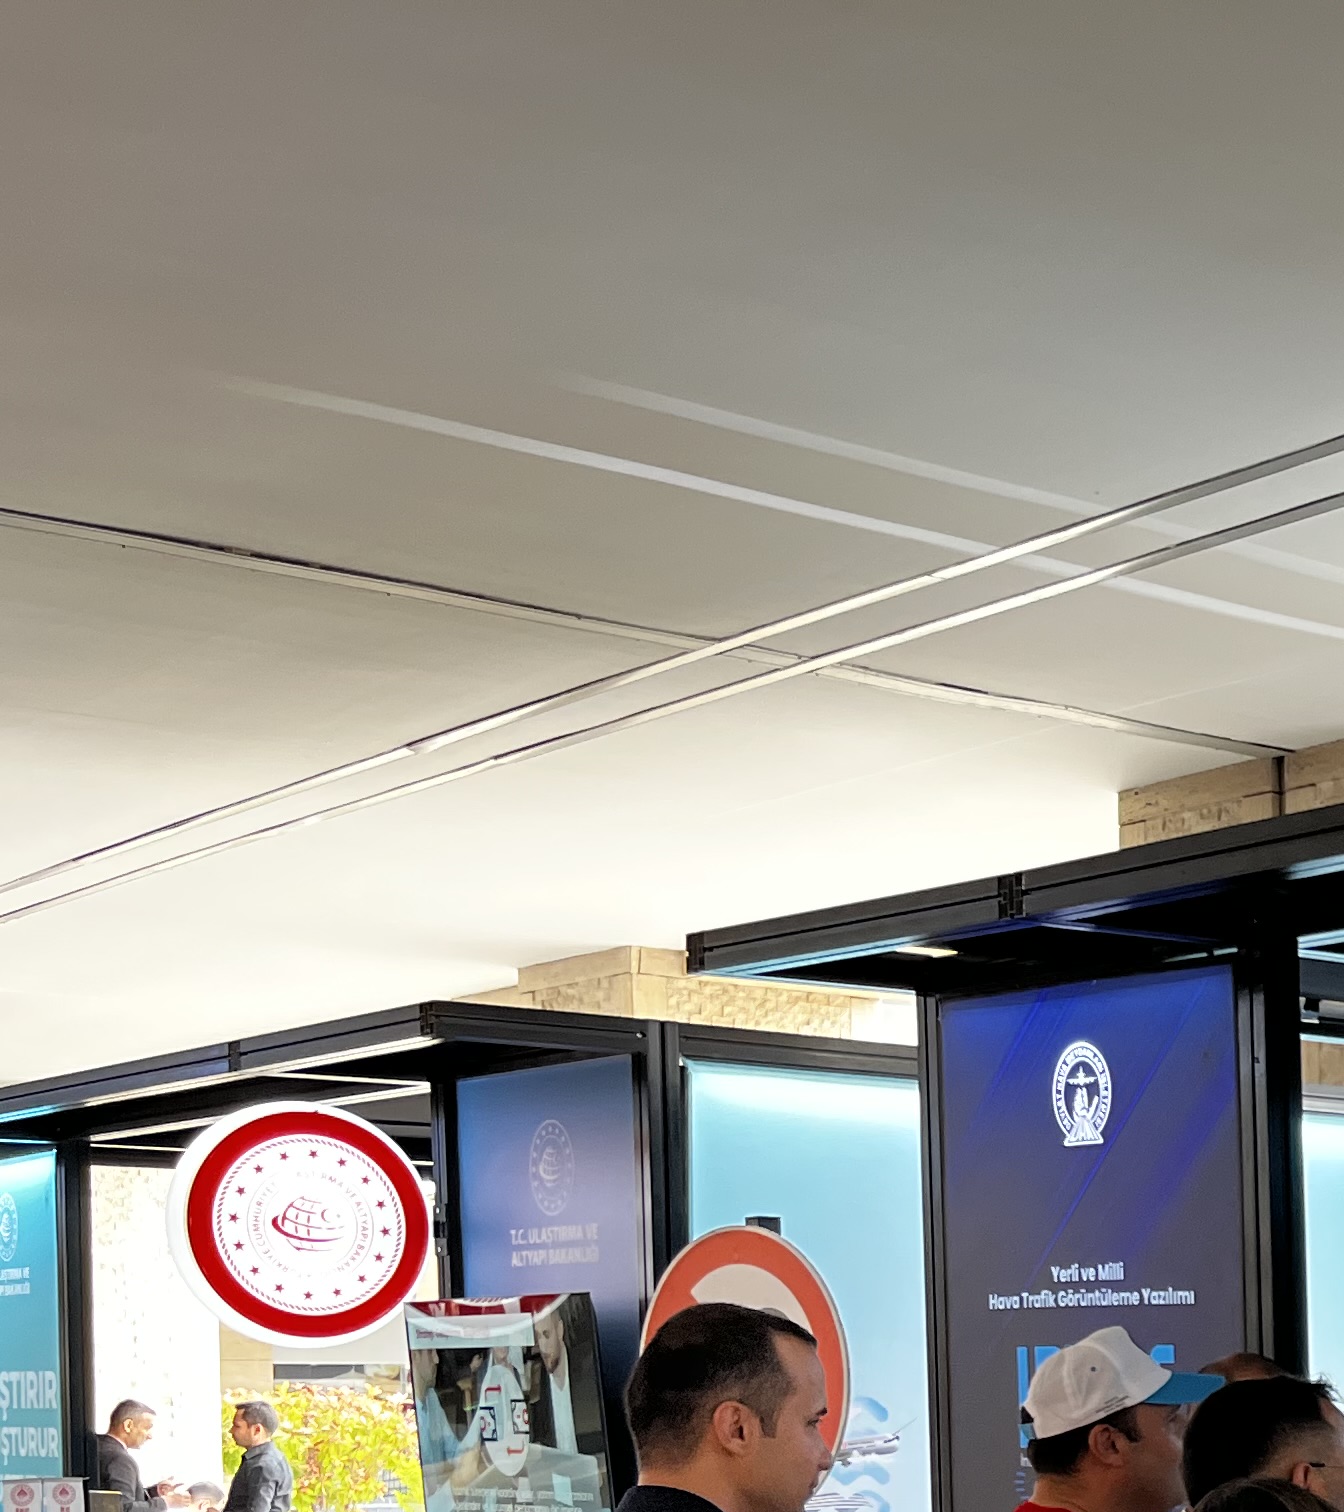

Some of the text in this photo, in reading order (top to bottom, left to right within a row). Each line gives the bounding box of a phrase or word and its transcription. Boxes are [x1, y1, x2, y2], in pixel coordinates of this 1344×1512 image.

[1050, 1261, 1125, 1283] Yerli ve Milli
[989, 1294, 1020, 1311] Hava
[1021, 1290, 1056, 1309] Trafik
[1057, 1288, 1140, 1308] Görüntüleme
